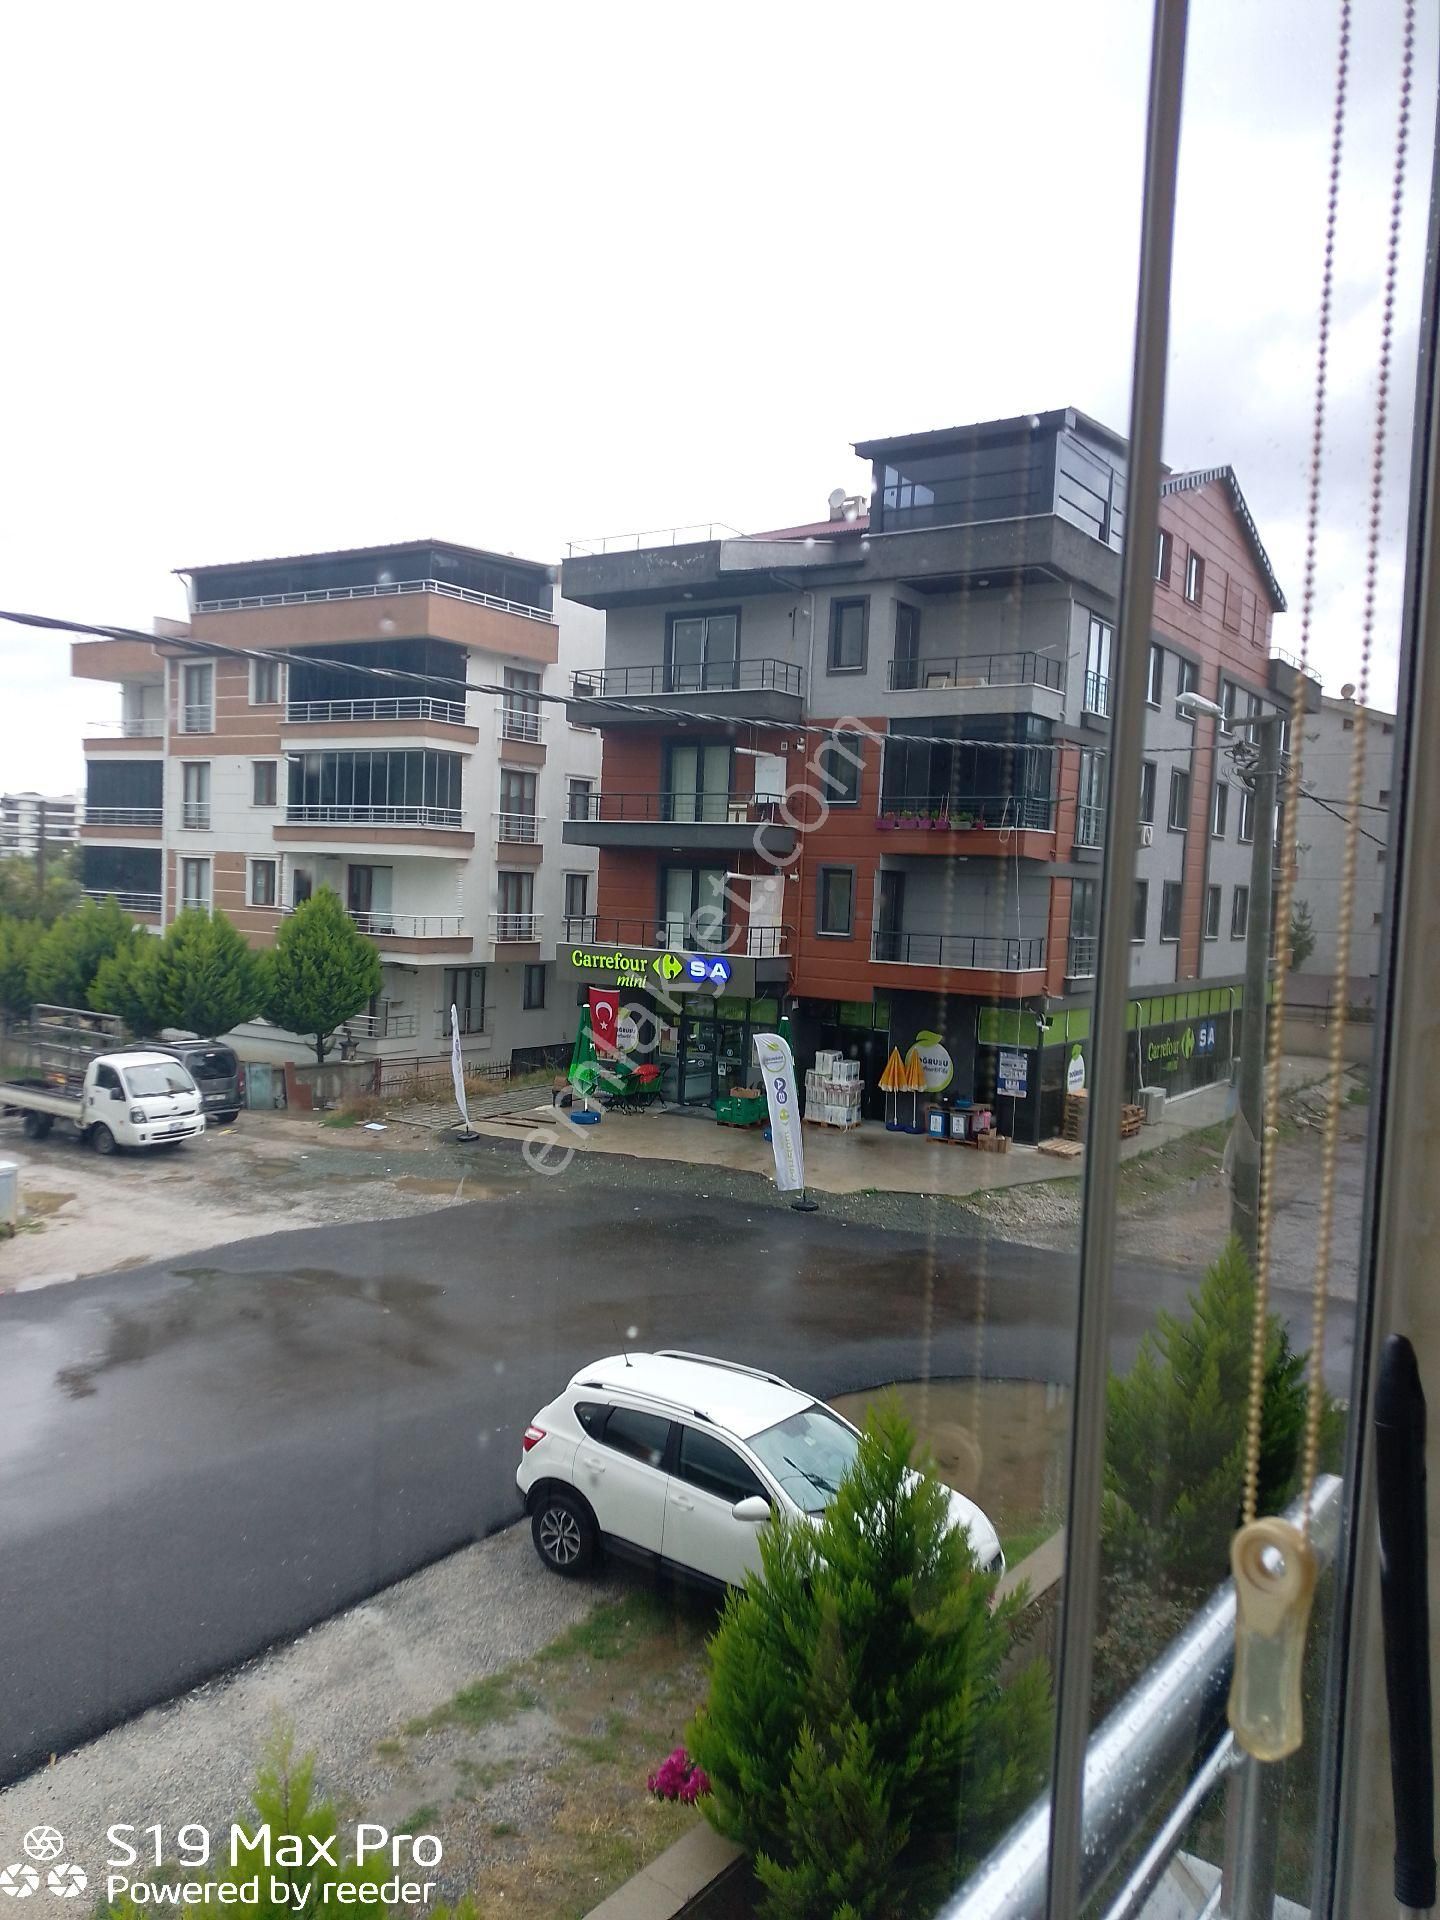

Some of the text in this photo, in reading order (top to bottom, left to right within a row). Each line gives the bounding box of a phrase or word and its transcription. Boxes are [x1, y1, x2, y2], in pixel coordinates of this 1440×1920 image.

[571, 949, 728, 979] Carrefour SA
[617, 973, 647, 988] mini
[1148, 1026, 1215, 1062] Carrefour SA
